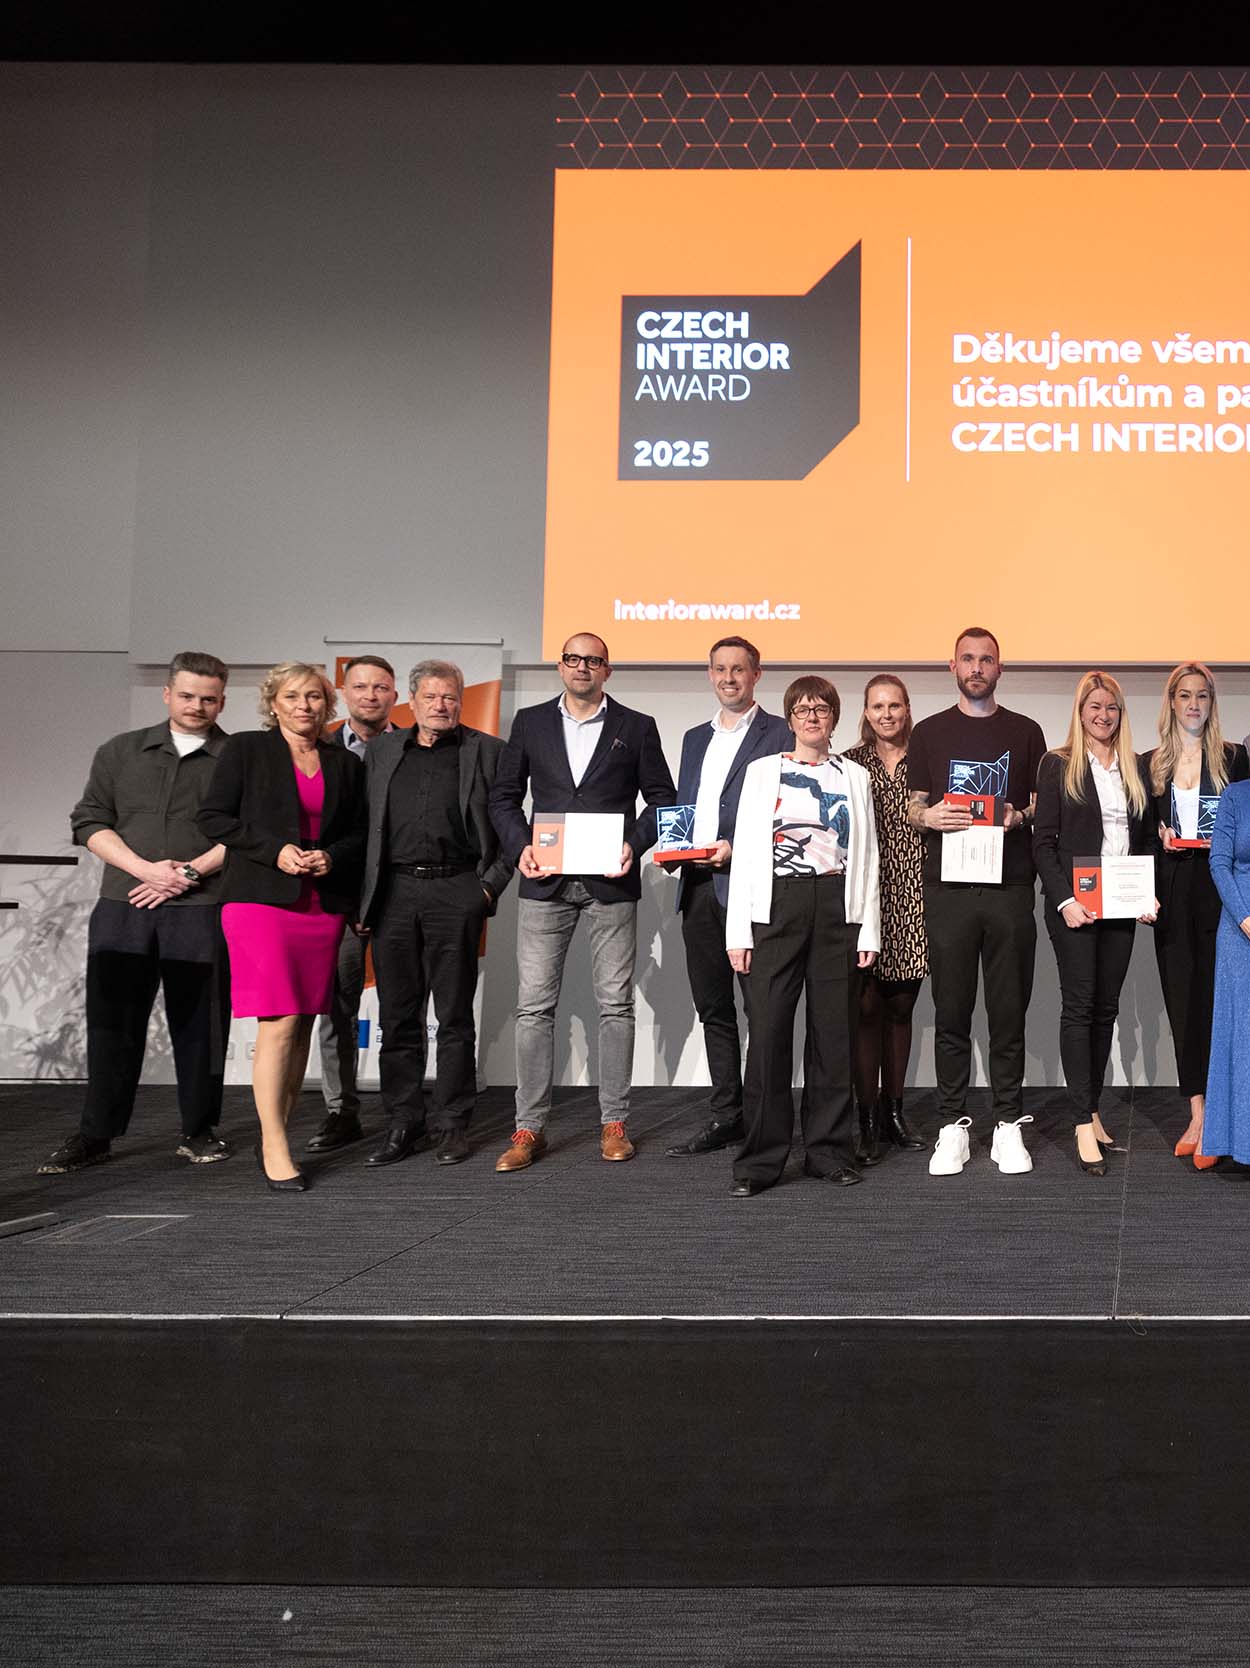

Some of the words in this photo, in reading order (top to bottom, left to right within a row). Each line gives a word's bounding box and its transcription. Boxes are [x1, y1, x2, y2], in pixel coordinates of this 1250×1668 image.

[636, 311, 749, 339] CZECH
[636, 342, 791, 370] INTERIOR
[952, 331, 1143, 370] Děkujeme
[634, 374, 751, 401] AWARD
[952, 374, 1173, 408] účastníkům
[1183, 384, 1205, 408] a
[951, 422, 1079, 452] CZECH
[633, 440, 710, 468] 2025
[614, 598, 801, 621] interioraward.cz
